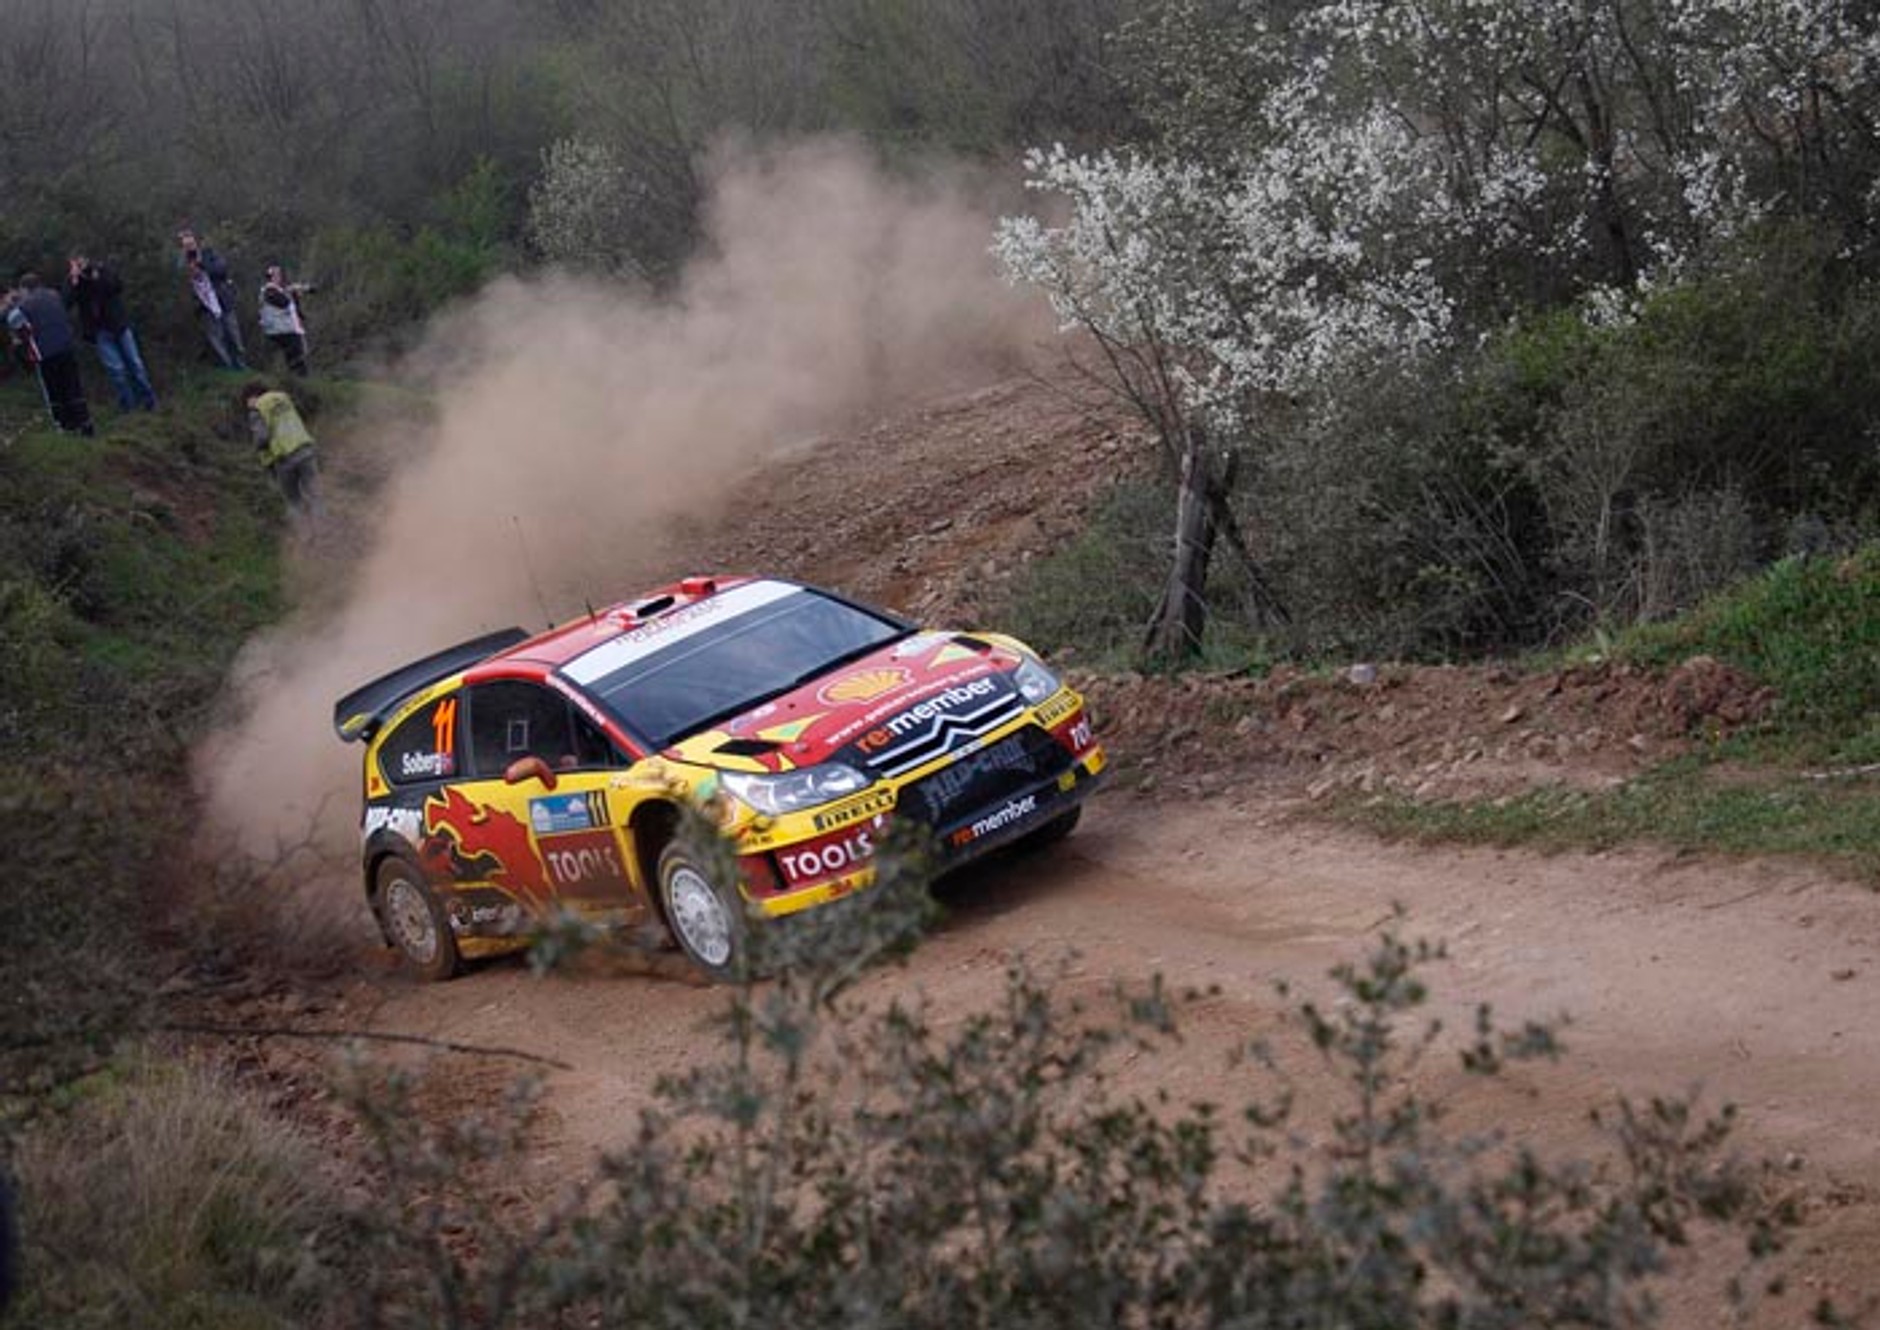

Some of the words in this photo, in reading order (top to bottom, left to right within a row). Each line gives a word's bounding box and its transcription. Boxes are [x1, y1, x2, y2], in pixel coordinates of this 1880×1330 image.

[431, 697, 456, 754] 11
[856, 676, 997, 754] re:member
[402, 751, 442, 776] Solberg
[813, 788, 895, 832] PIRELLI
[951, 794, 1036, 848] re:member
[782, 832, 872, 880] TOOLS
